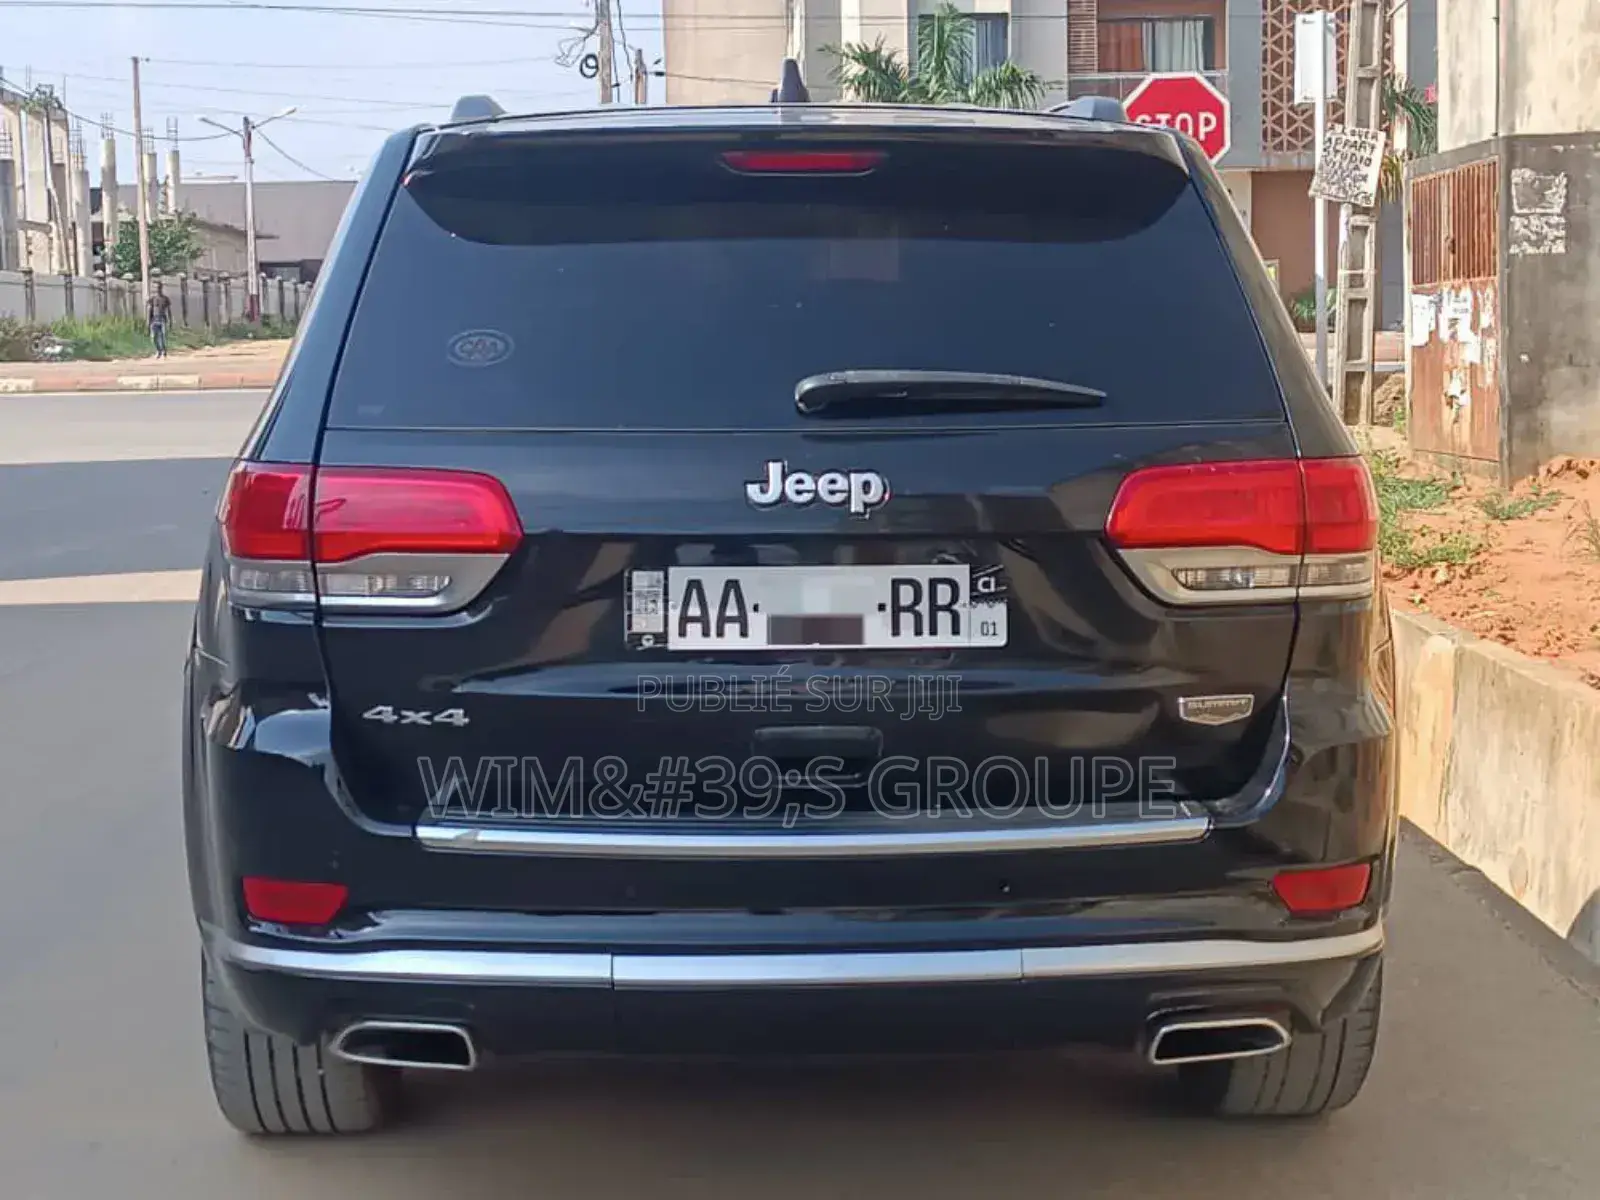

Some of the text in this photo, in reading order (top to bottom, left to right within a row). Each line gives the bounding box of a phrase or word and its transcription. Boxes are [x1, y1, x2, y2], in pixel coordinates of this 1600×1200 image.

[745, 460, 889, 518] Jeep
[979, 620, 999, 637] 01
[362, 704, 471, 728] 4x4
